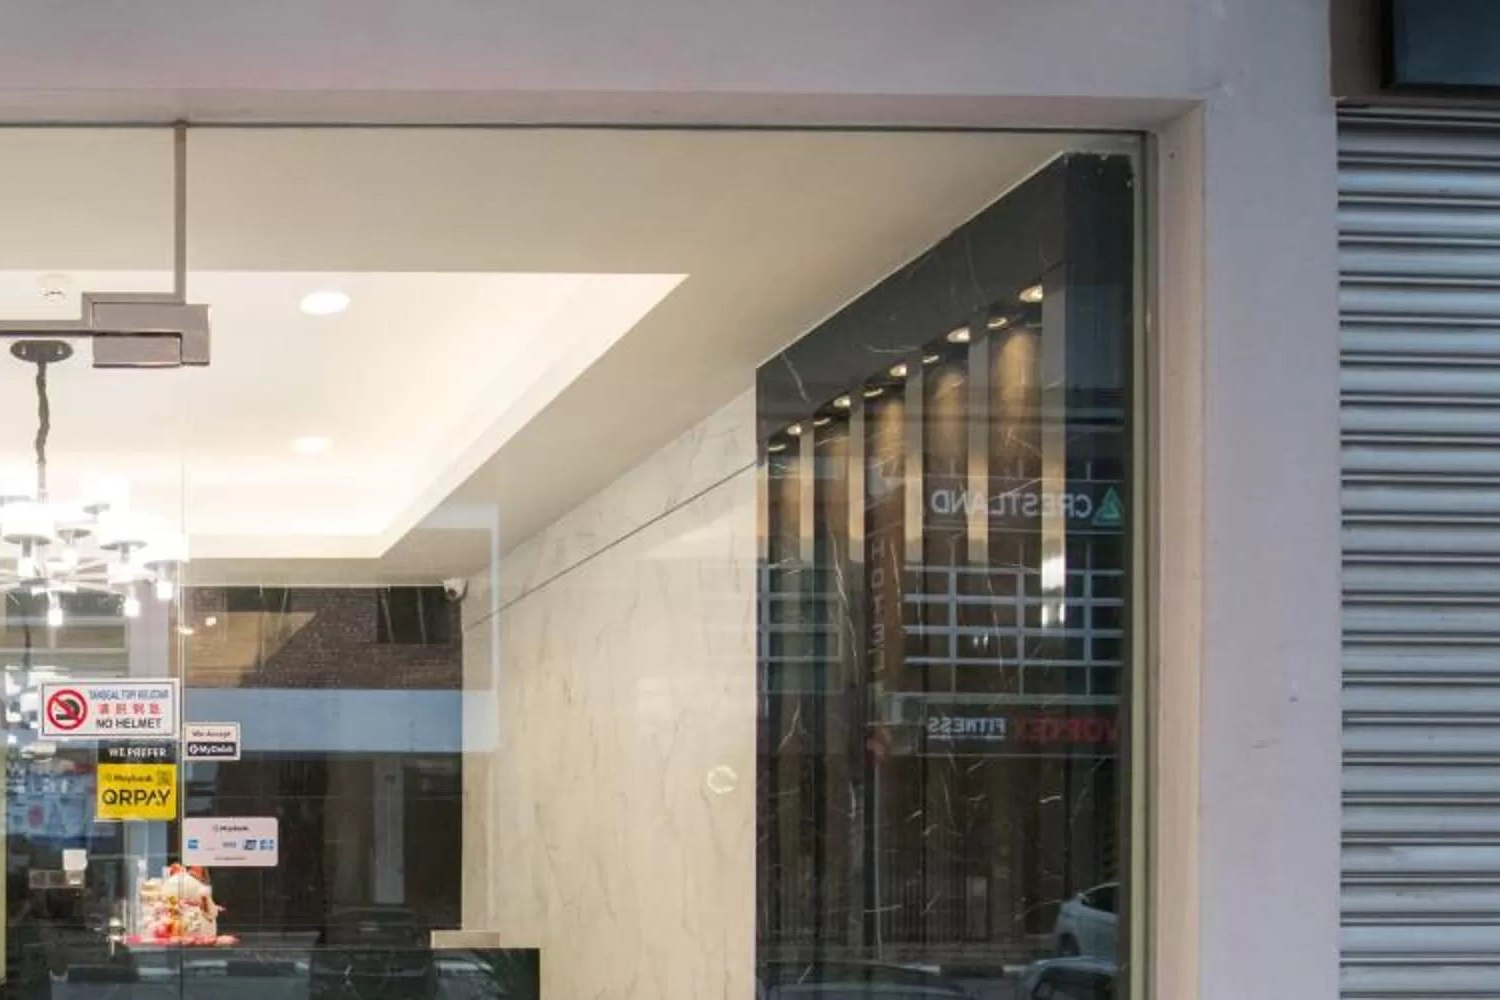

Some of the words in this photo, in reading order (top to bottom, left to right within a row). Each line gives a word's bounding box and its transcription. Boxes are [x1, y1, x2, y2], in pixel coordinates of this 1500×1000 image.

[96, 718, 113, 729] NO
[115, 718, 162, 729] HELMET
[108, 747, 125, 757] WE
[127, 747, 167, 757] PREFER
[101, 788, 171, 806] QRPAY
